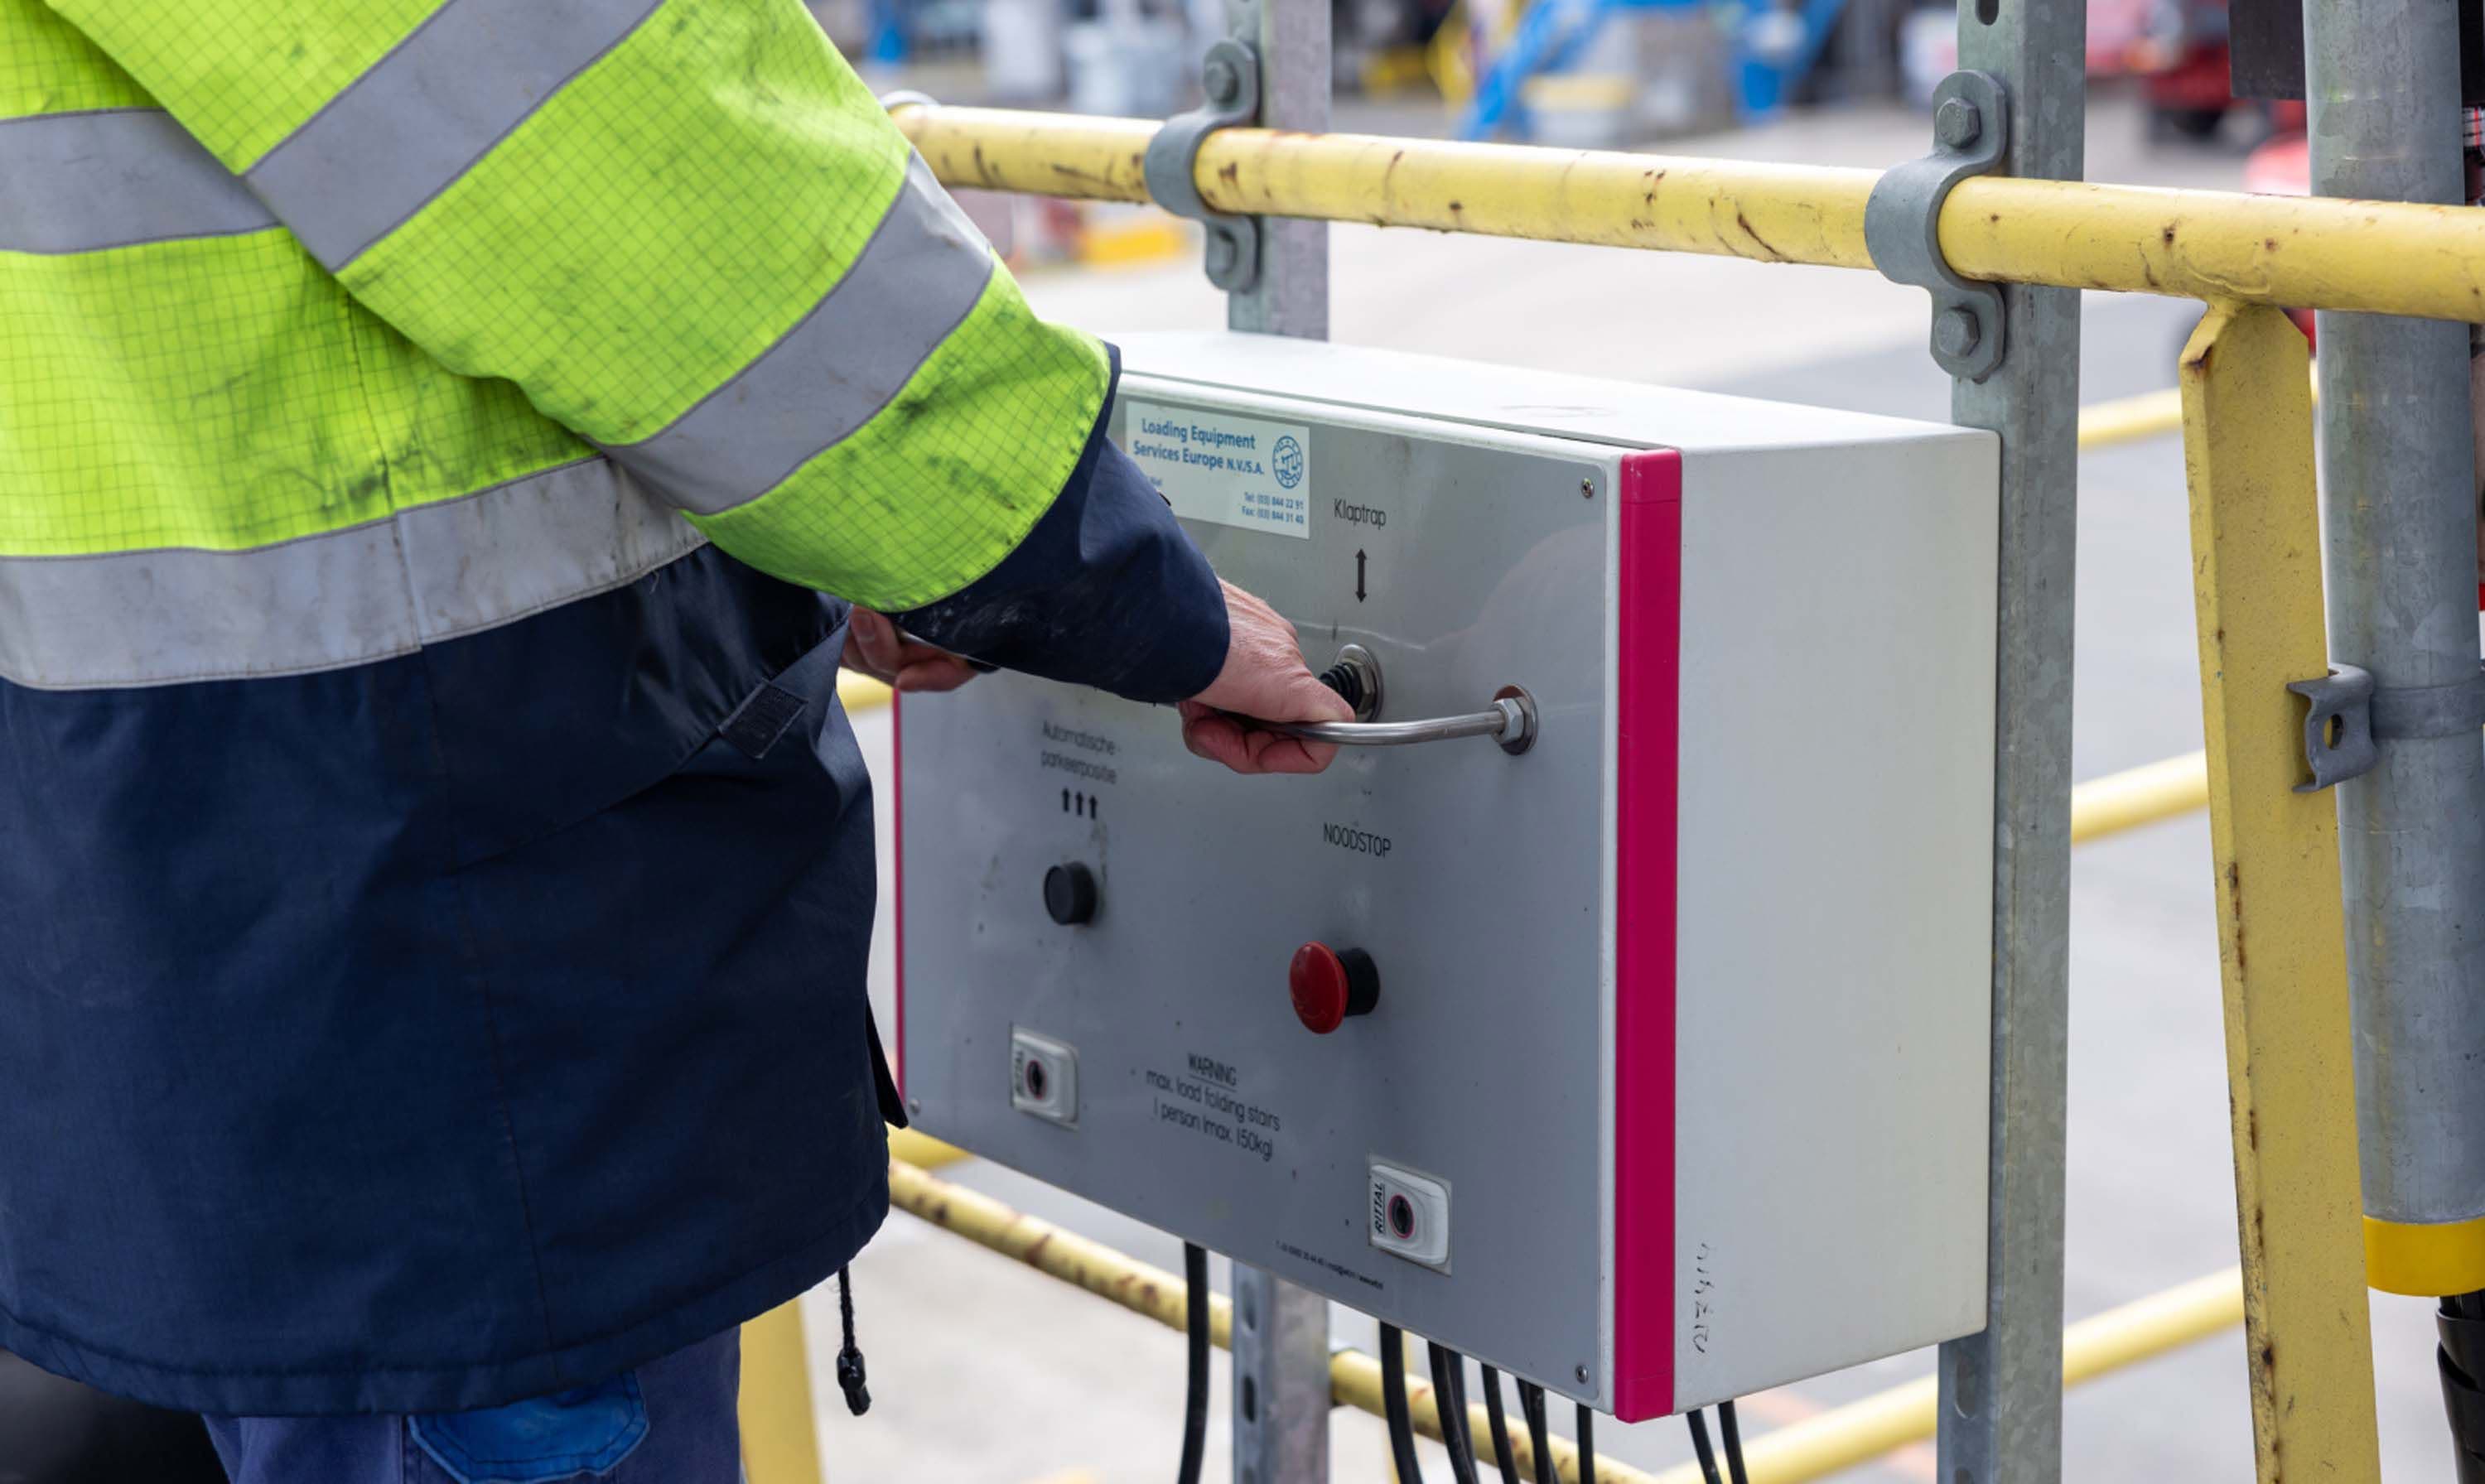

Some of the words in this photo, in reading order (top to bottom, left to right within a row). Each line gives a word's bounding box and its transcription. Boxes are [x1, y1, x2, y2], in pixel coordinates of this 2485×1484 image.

[1141, 418, 1188, 442] Loading
[1190, 425, 1256, 449] Equipment
[1133, 440, 1180, 462] Services
[1182, 448, 1223, 470] Europe
[1334, 498, 1387, 531] Klaptrap
[1043, 720, 1116, 755] Automatische
[1323, 822, 1392, 858] NOODSTOP
[1188, 1053, 1237, 1086] WARNING
[1146, 1070, 1174, 1093] max.
[1176, 1077, 1201, 1102] load
[1204, 1086, 1246, 1124] folding
[1247, 1106, 1281, 1132] stairs
[1161, 1103, 1201, 1132] person
[1374, 1183, 1383, 1235] RITTAL
